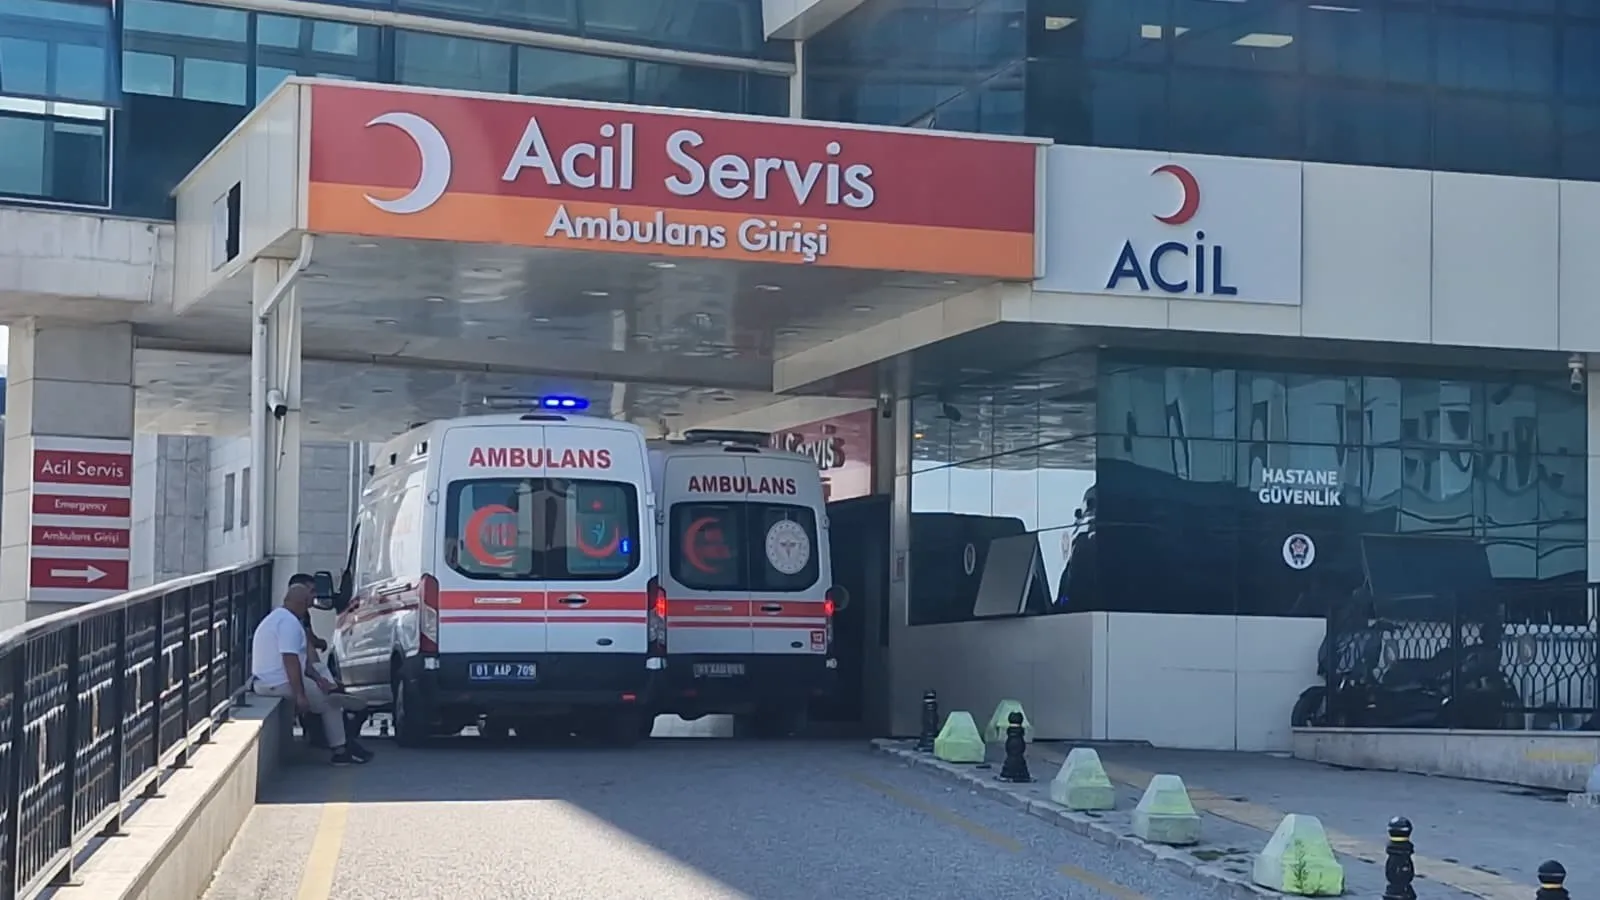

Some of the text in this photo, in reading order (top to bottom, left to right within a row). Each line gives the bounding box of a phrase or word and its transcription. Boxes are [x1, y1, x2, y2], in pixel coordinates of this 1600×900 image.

[502, 115, 876, 209] Acil Servis
[545, 204, 829, 263] Ambulans Girişi
[1106, 230, 1238, 295] ACİL
[468, 446, 612, 469] AMBULANS
[41, 459, 124, 478] Acil Servis
[1261, 467, 1338, 486] HASTANE
[688, 475, 797, 495] AMBULANS
[54, 498, 108, 512] Emergency
[1258, 485, 1341, 506] GÜVENLİK
[42, 529, 91, 542] Ambulans
[476, 664, 488, 676] 01
